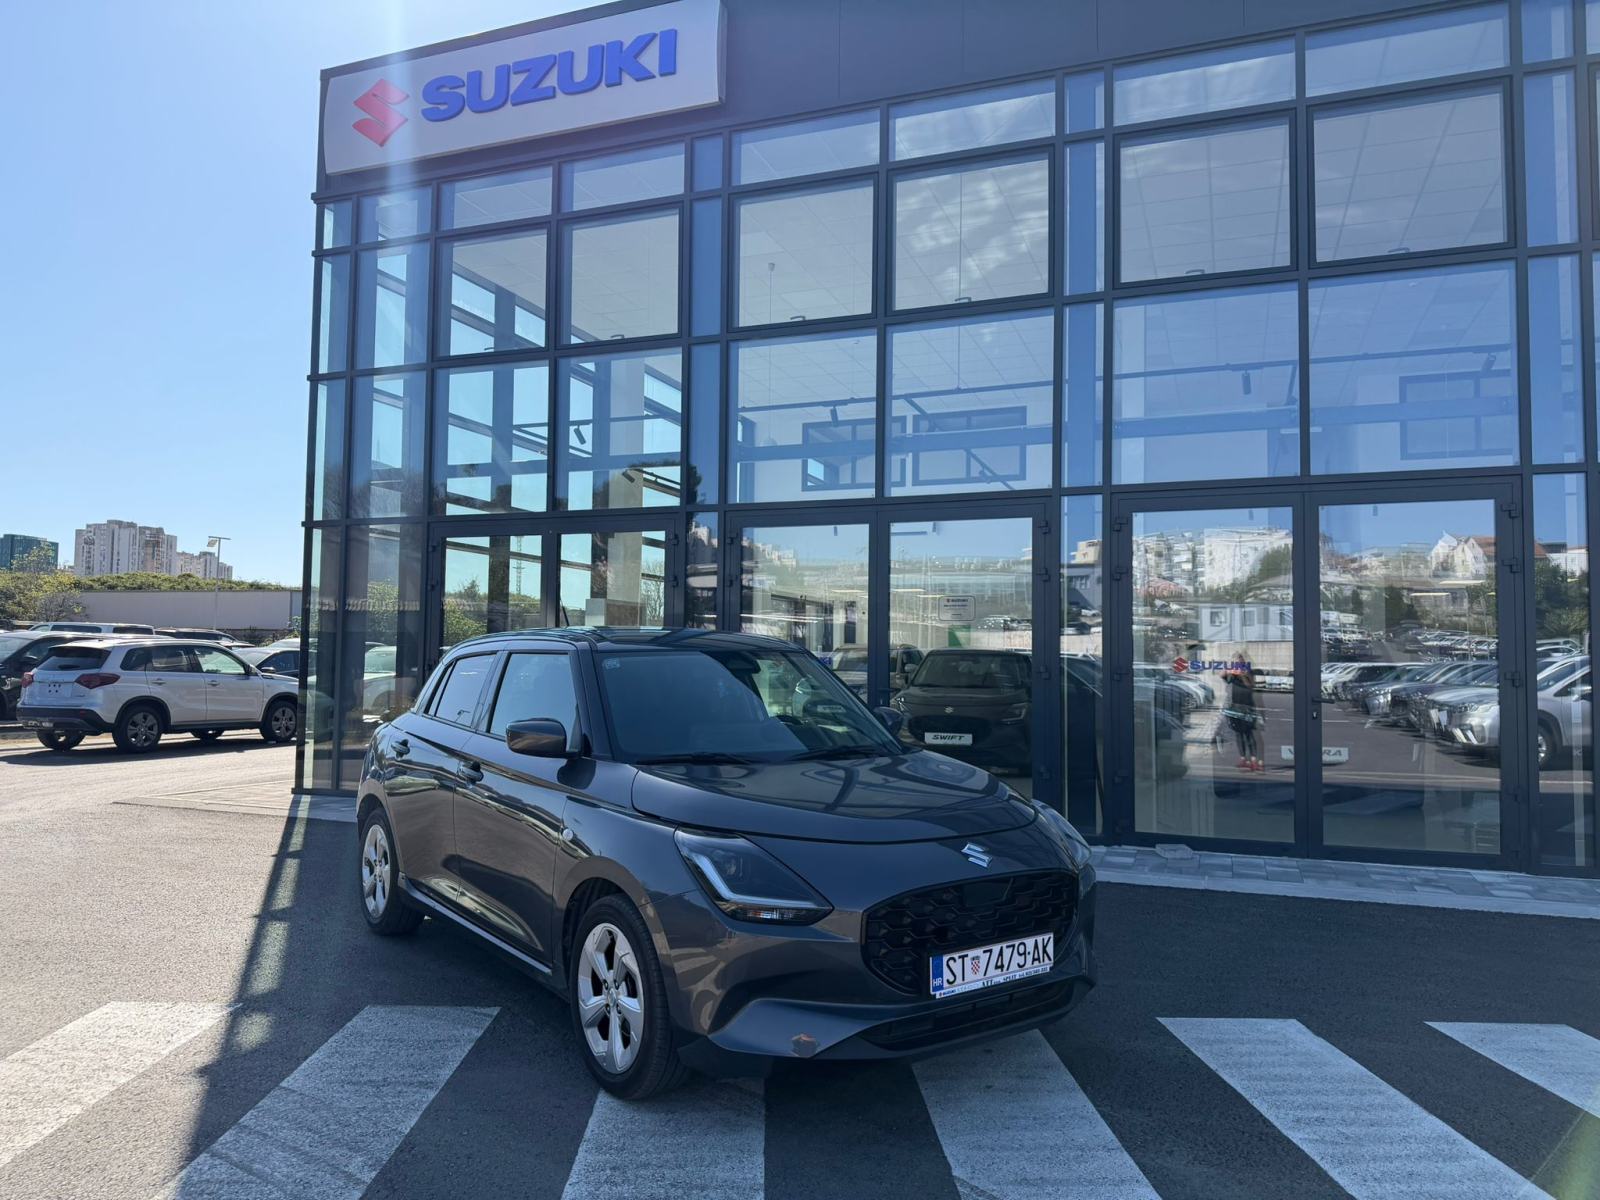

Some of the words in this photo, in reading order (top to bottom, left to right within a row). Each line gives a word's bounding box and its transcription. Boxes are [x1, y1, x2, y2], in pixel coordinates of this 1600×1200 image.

[421, 28, 678, 122] SUZUKI
[932, 977, 943, 987] HR
[946, 953, 969, 986] ST
